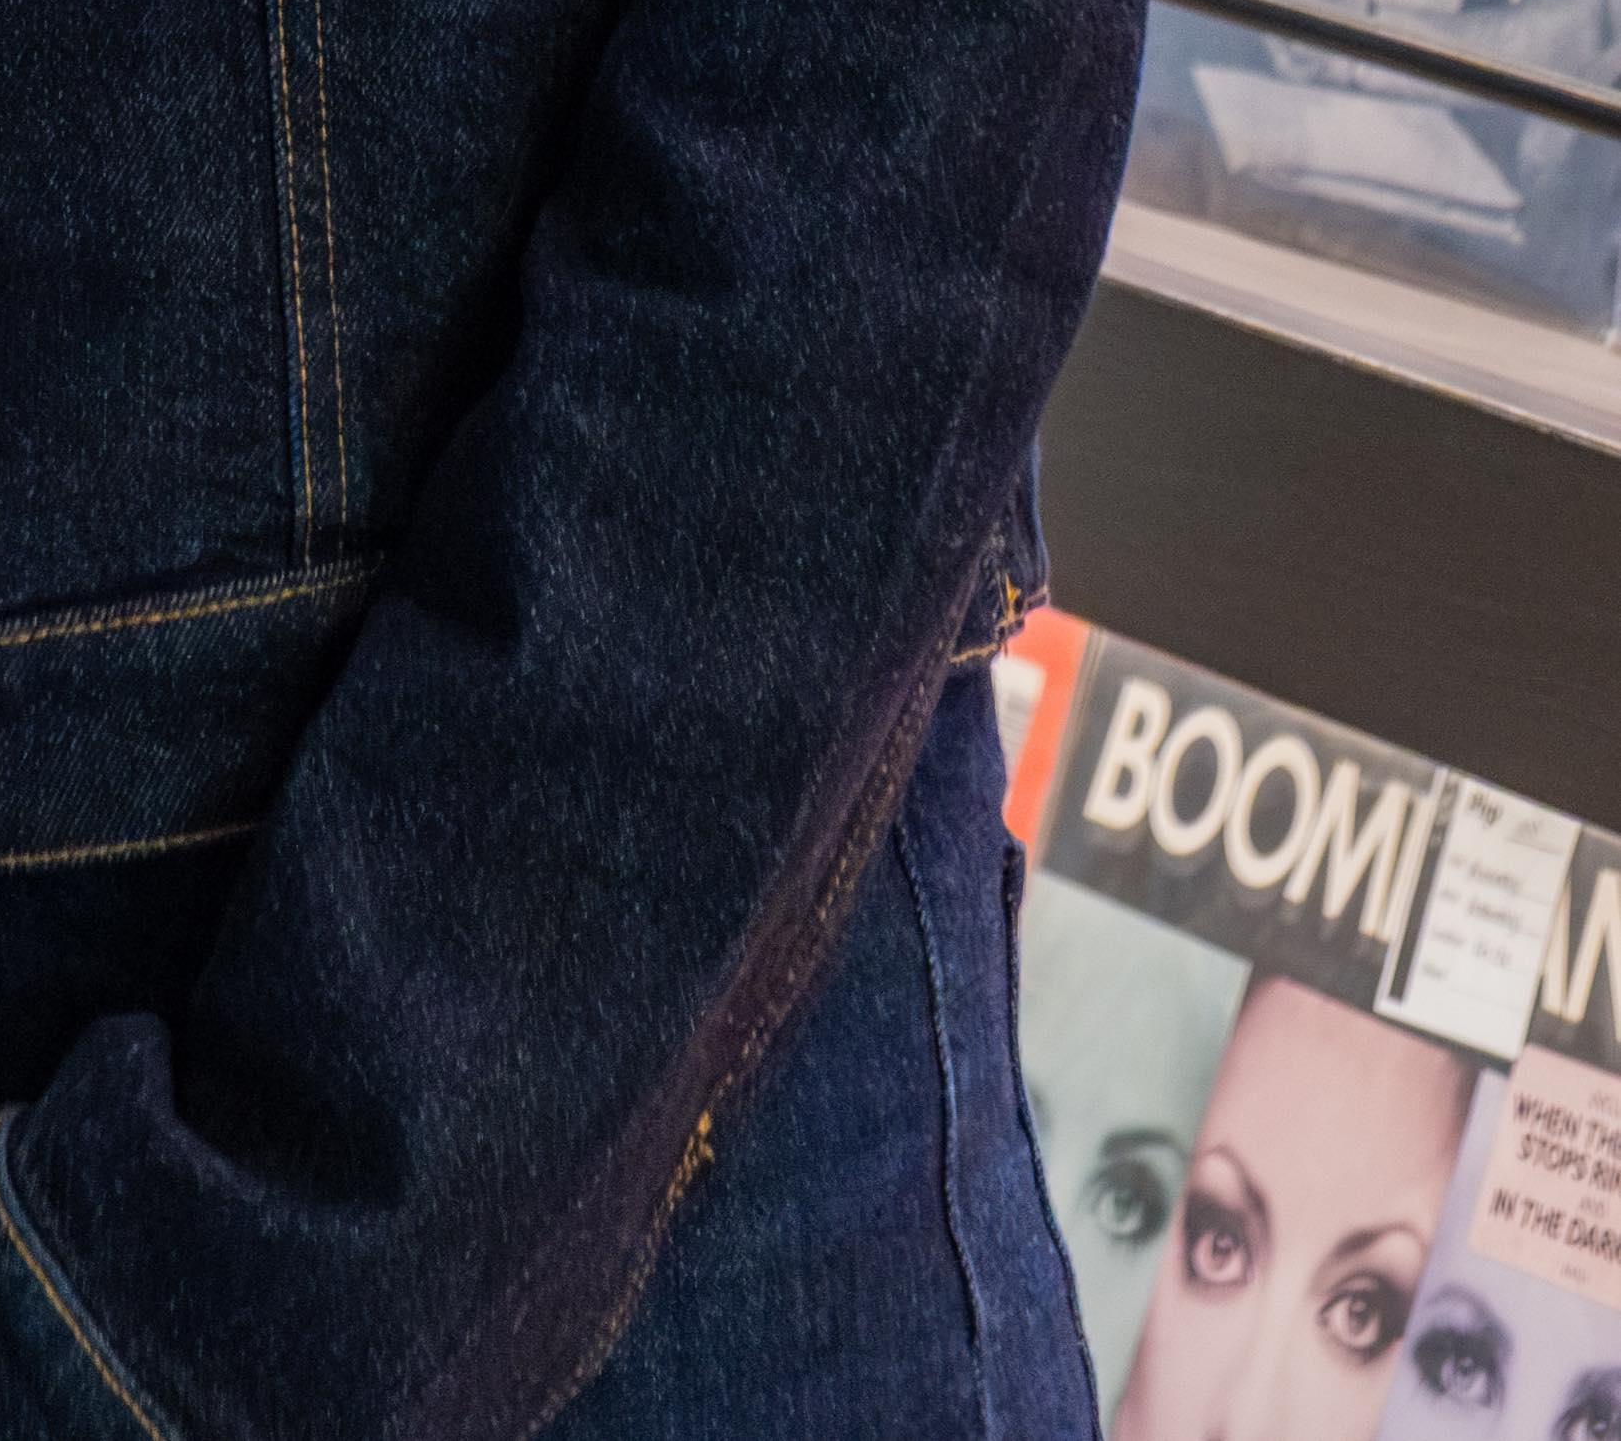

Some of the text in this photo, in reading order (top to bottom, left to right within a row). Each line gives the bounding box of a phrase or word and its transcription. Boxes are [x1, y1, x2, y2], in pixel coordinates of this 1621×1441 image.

[1512, 1090, 1583, 1138] WHEN
[1517, 1132, 1588, 1182] STOPS
[1489, 1187, 1520, 1221] IN
[1519, 1195, 1566, 1240] THE
